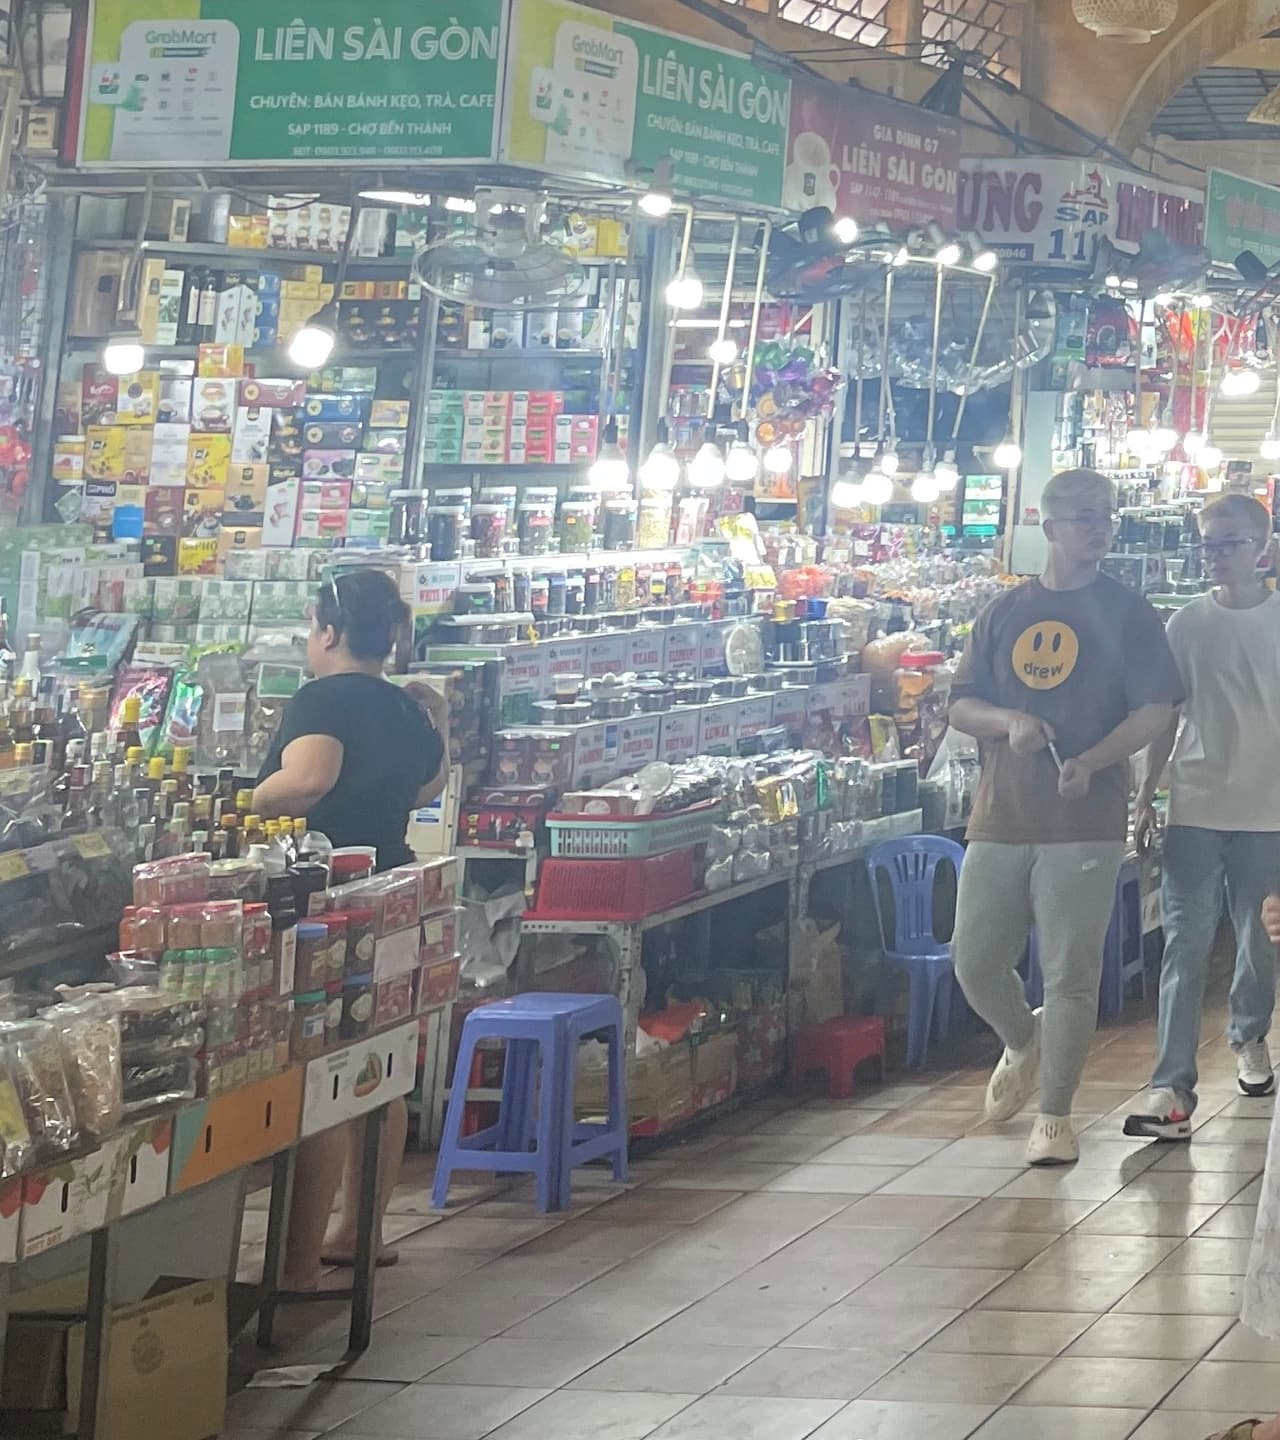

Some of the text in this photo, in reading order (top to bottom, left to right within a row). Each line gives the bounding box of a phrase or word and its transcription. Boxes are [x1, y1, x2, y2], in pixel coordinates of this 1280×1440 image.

[254, 18, 499, 62] LIÊN SÀI GÒN
[249, 93, 312, 111] CHUYÊN:
[346, 93, 387, 110] BÁNH
[642, 49, 789, 129] LIÊN SÀI GÒN
[842, 143, 881, 179] LIÊN
[887, 152, 916, 187] SÀI
[1022, 662, 1065, 680] drew
